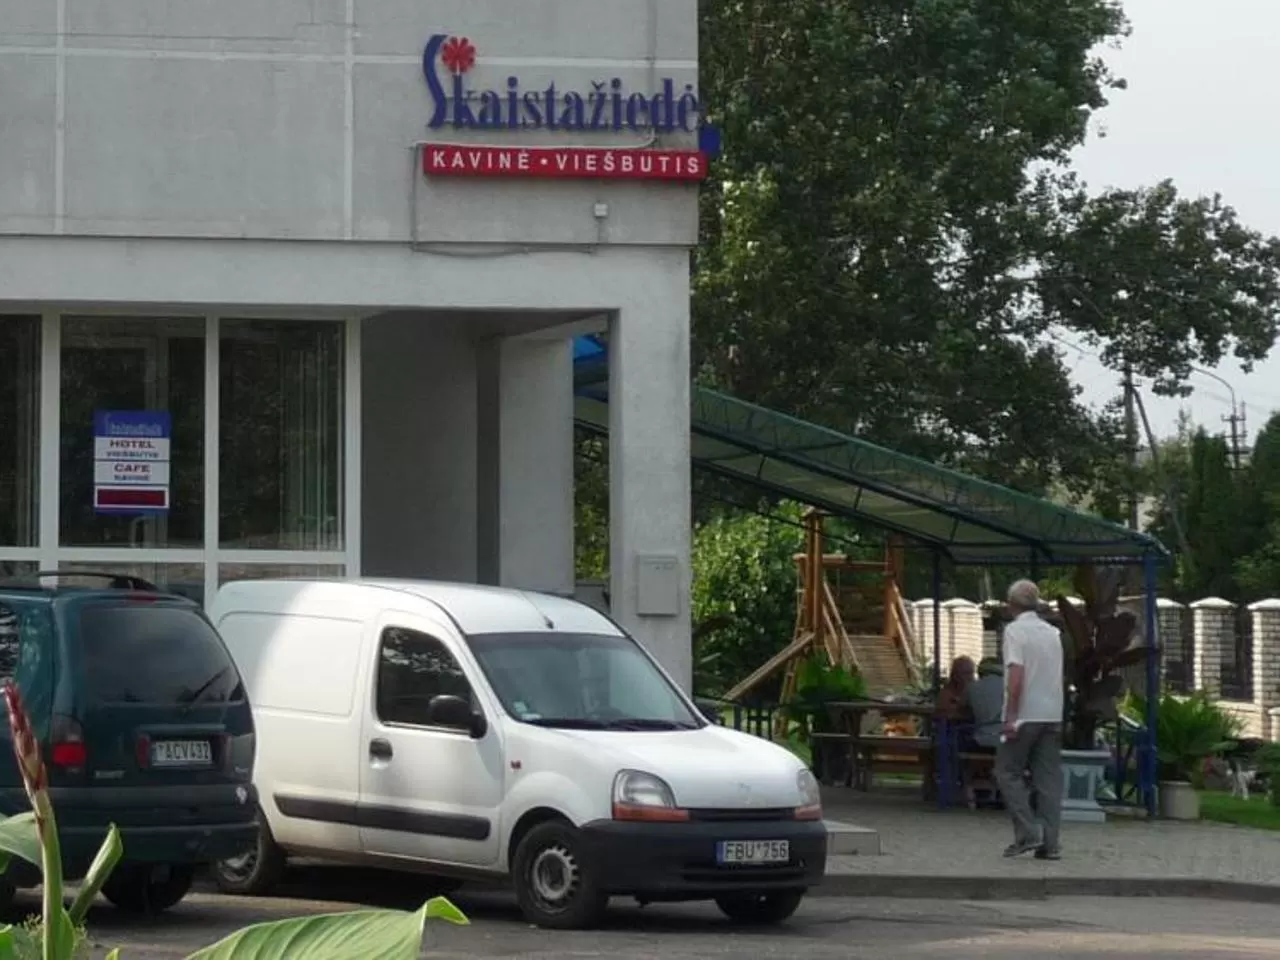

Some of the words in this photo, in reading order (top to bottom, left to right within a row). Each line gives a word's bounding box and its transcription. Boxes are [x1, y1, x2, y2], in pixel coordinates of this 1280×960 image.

[423, 34, 706, 132] Skaistažiedė
[432, 149, 530, 171] KAVINĖ
[555, 152, 700, 174] VIEŠBUTIS
[109, 439, 156, 449] HOTEL
[114, 463, 151, 473] CAFE
